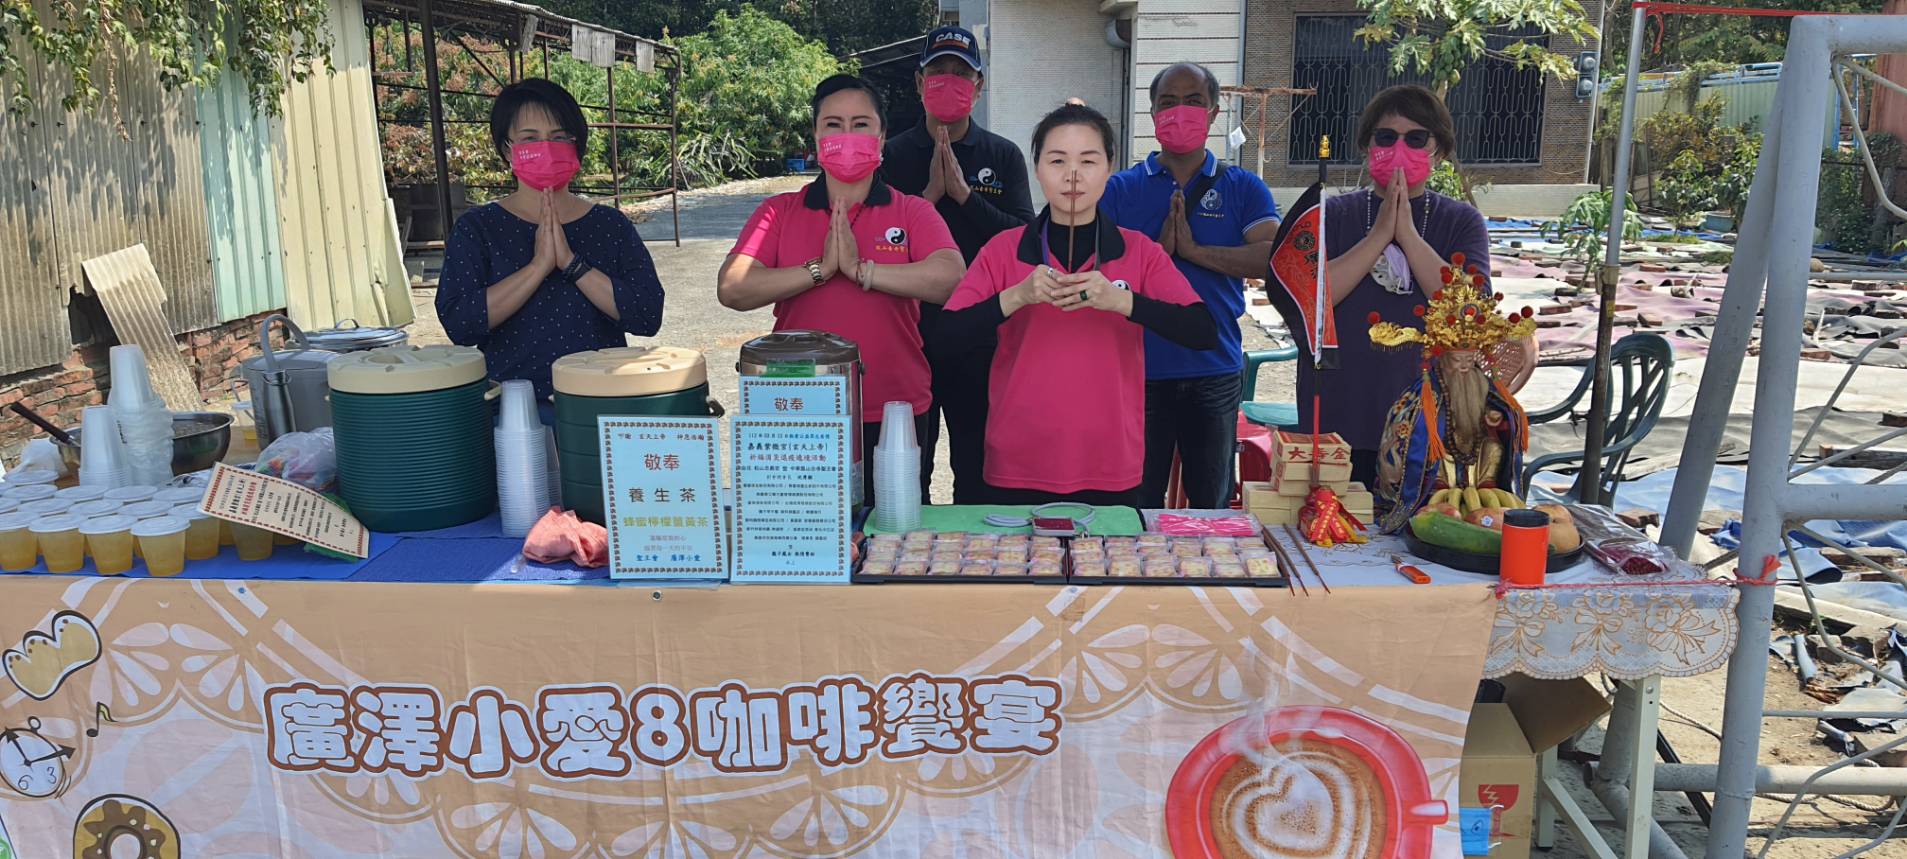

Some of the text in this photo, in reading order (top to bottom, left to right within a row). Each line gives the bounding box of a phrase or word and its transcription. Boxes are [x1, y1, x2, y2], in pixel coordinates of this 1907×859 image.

[936, 32, 970, 45] CASE
[774, 397, 804, 411] 敬奉
[644, 453, 680, 471] 敬奉
[629, 487, 696, 503] 養生茶
[263, 673, 1063, 780] 廣澤小愛8咖啡饗宴
